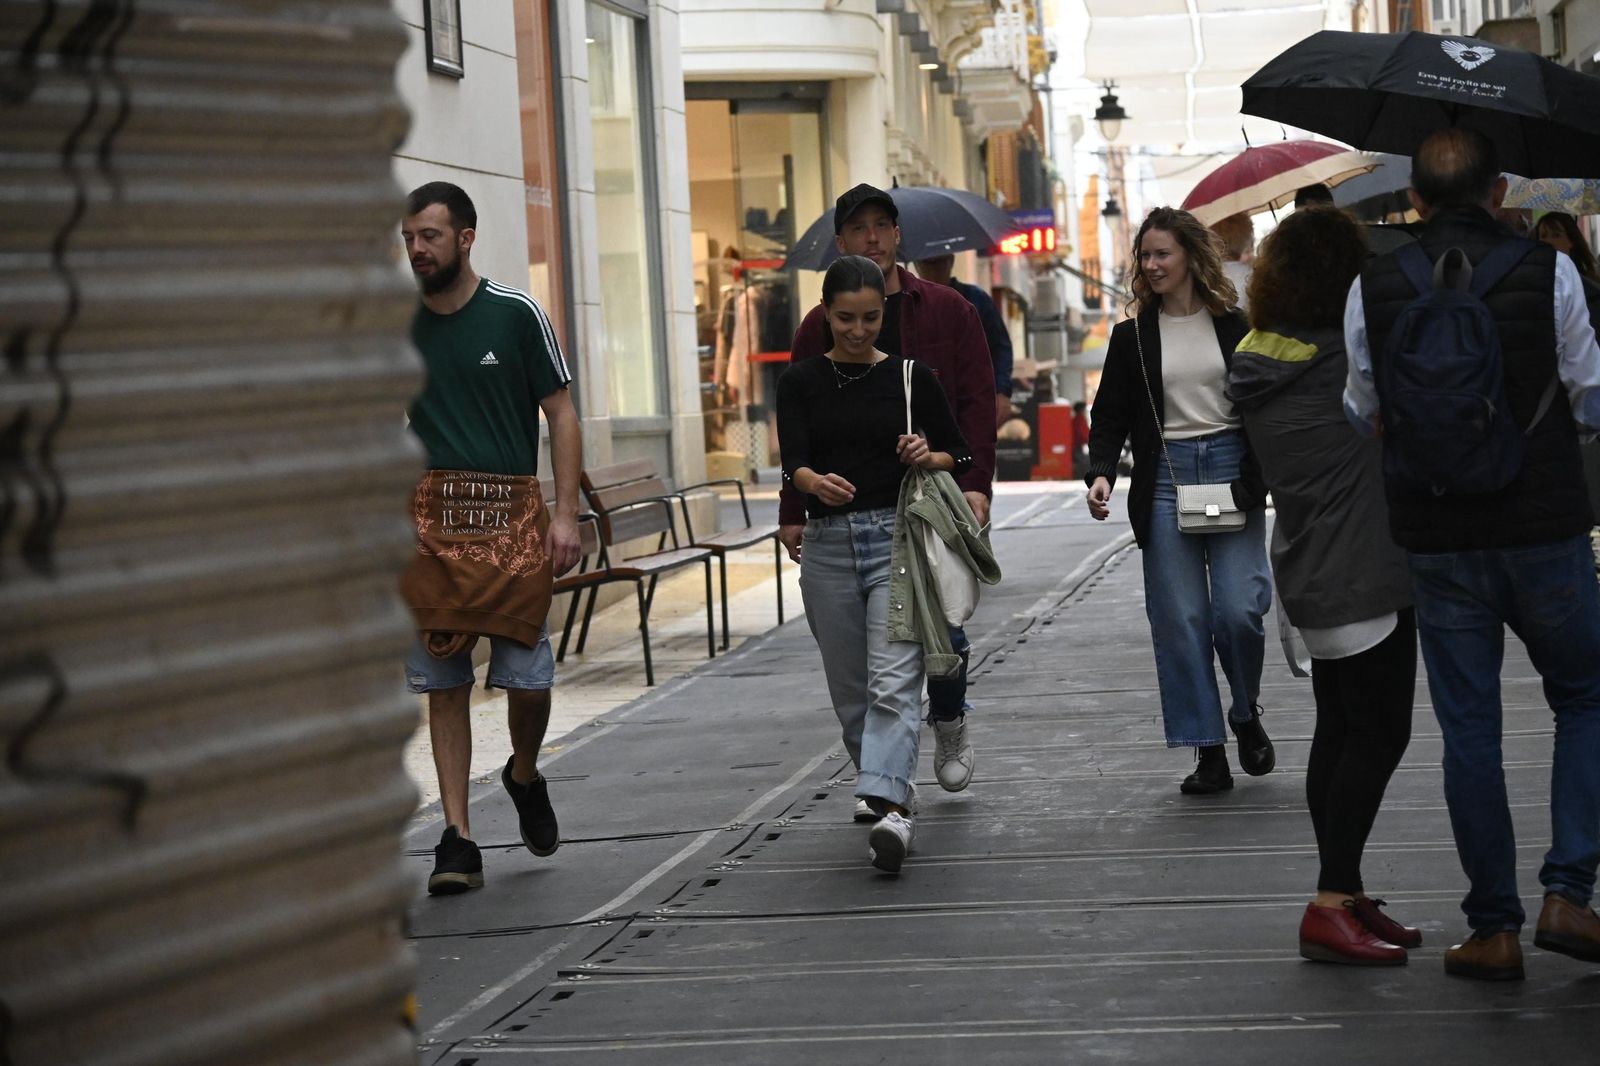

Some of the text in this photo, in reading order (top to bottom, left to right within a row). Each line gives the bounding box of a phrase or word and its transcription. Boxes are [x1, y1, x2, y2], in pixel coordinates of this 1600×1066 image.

[1418, 71, 1437, 80] Eres
[1452, 78, 1479, 88] rayito
[1480, 81, 1491, 89] de
[443, 482, 511, 499] IUTER
[443, 510, 508, 527] IUTER
